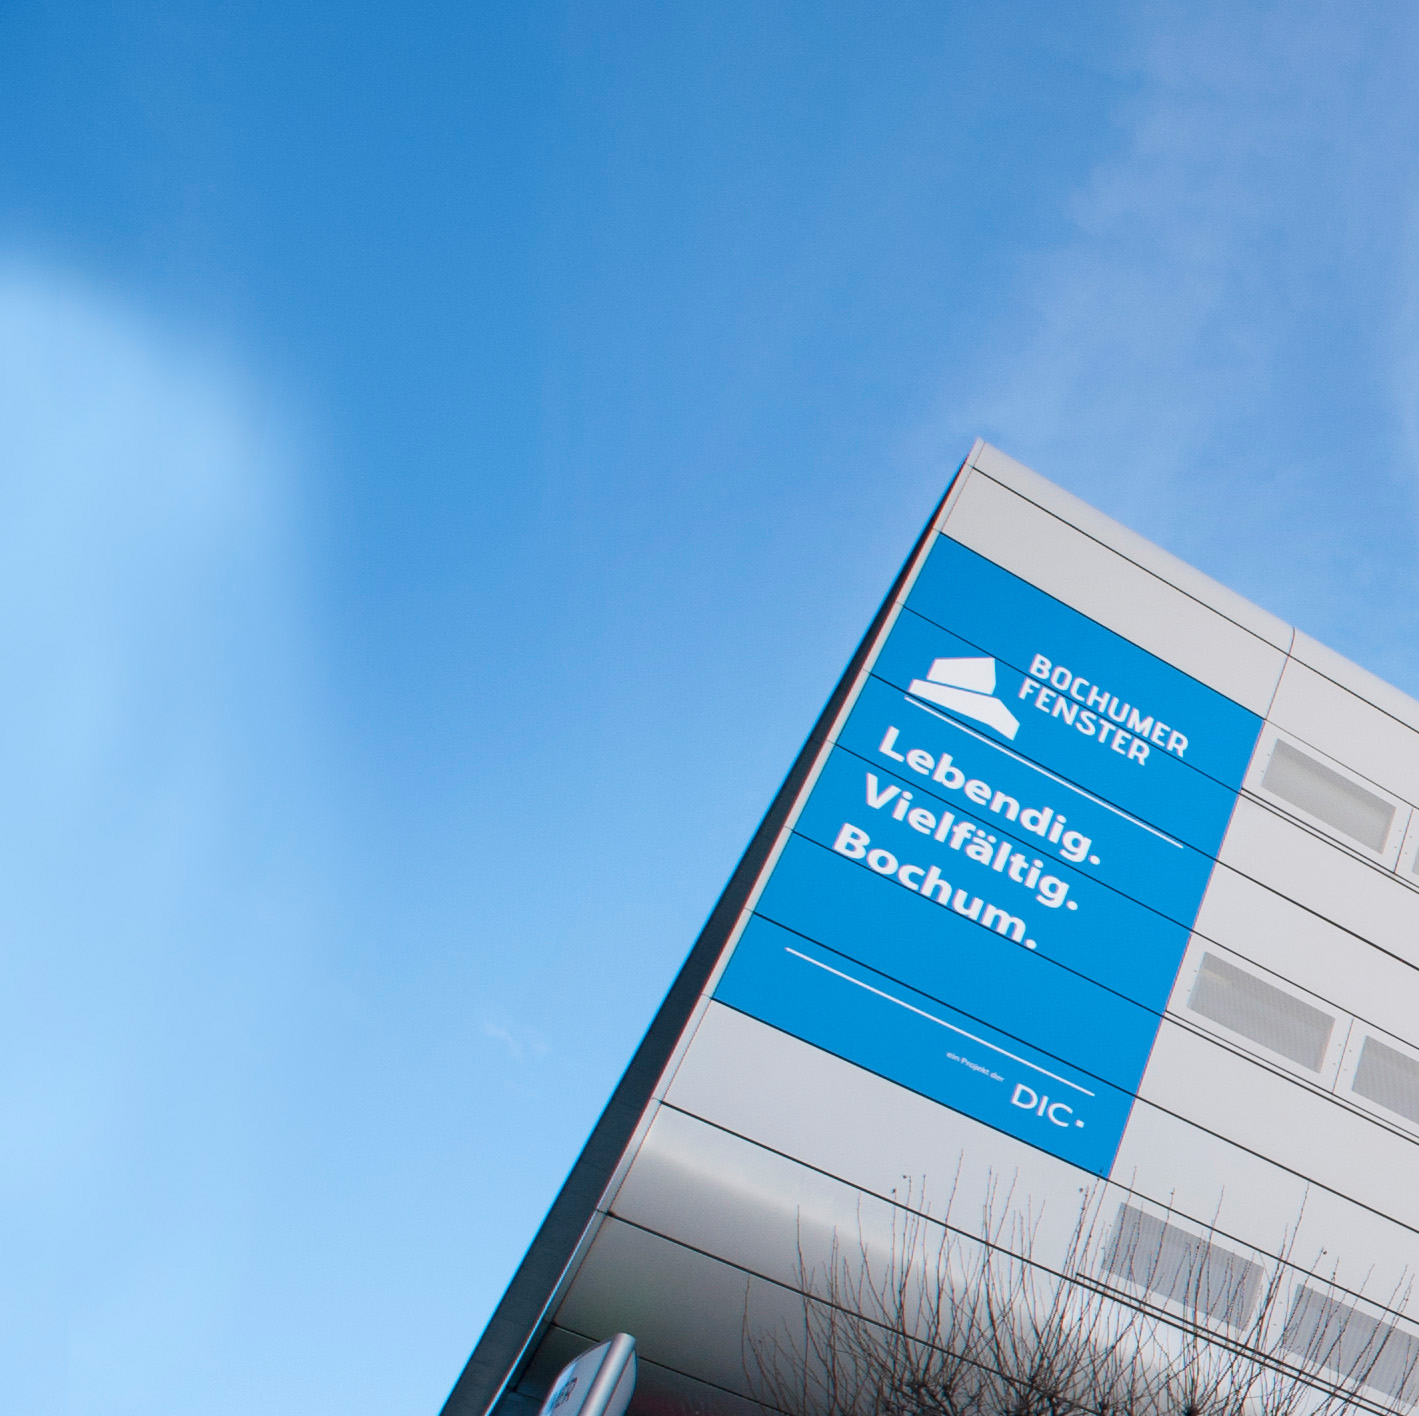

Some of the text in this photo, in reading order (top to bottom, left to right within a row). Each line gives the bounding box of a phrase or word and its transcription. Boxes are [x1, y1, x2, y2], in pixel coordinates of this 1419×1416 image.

[1018, 677, 1151, 766] FENSTER
[1029, 653, 1189, 758] BOCHUMER
[866, 772, 1079, 911] Vielfältig.
[879, 726, 1101, 866] Lebendig.
[832, 823, 1038, 950] Bochum.
